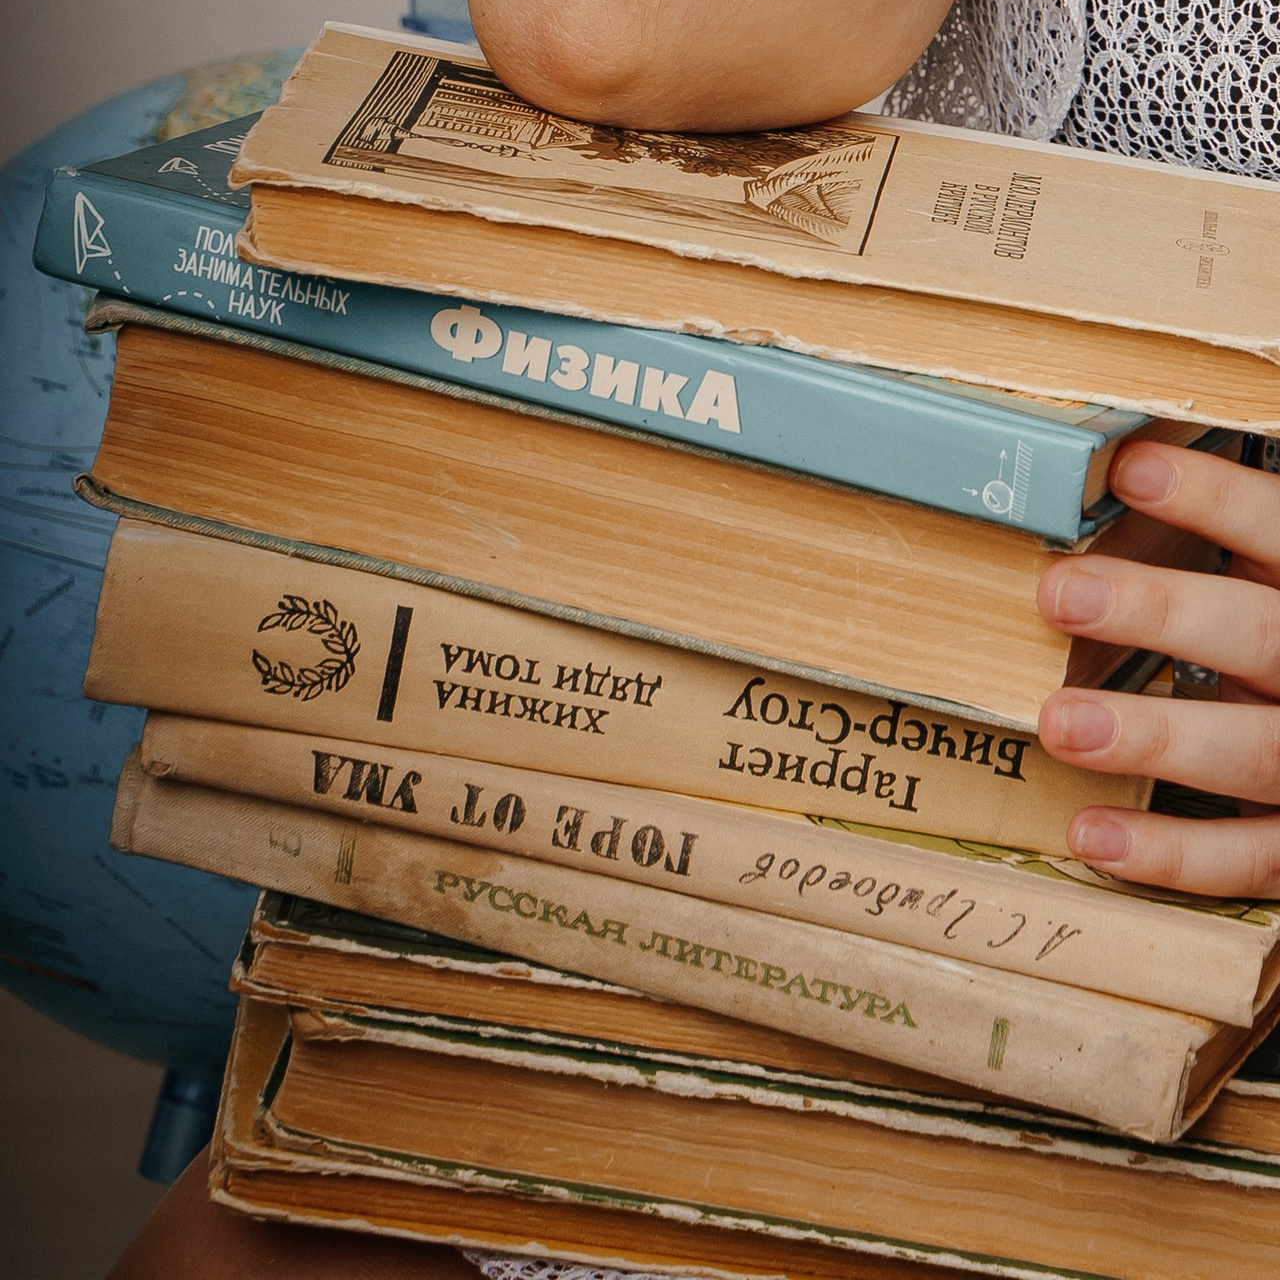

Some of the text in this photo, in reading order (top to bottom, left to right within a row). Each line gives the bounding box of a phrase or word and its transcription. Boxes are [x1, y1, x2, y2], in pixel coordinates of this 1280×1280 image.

[173, 248, 350, 315] ЗАНИМАТЕЛЬНЫХ
[228, 290, 286, 326] НАУК
[433, 680, 610, 735] ХИЖИНА
[439, 643, 664, 708] ДЯДИ ТОМА
[722, 676, 1032, 782] Бичер-Стоу
[718, 741, 920, 813] Гарриет
[310, 749, 700, 877] ГОРЕ ОТ УМА
[433, 871, 918, 1030] РУССКАЯ ЛИТЕРАТУРА
